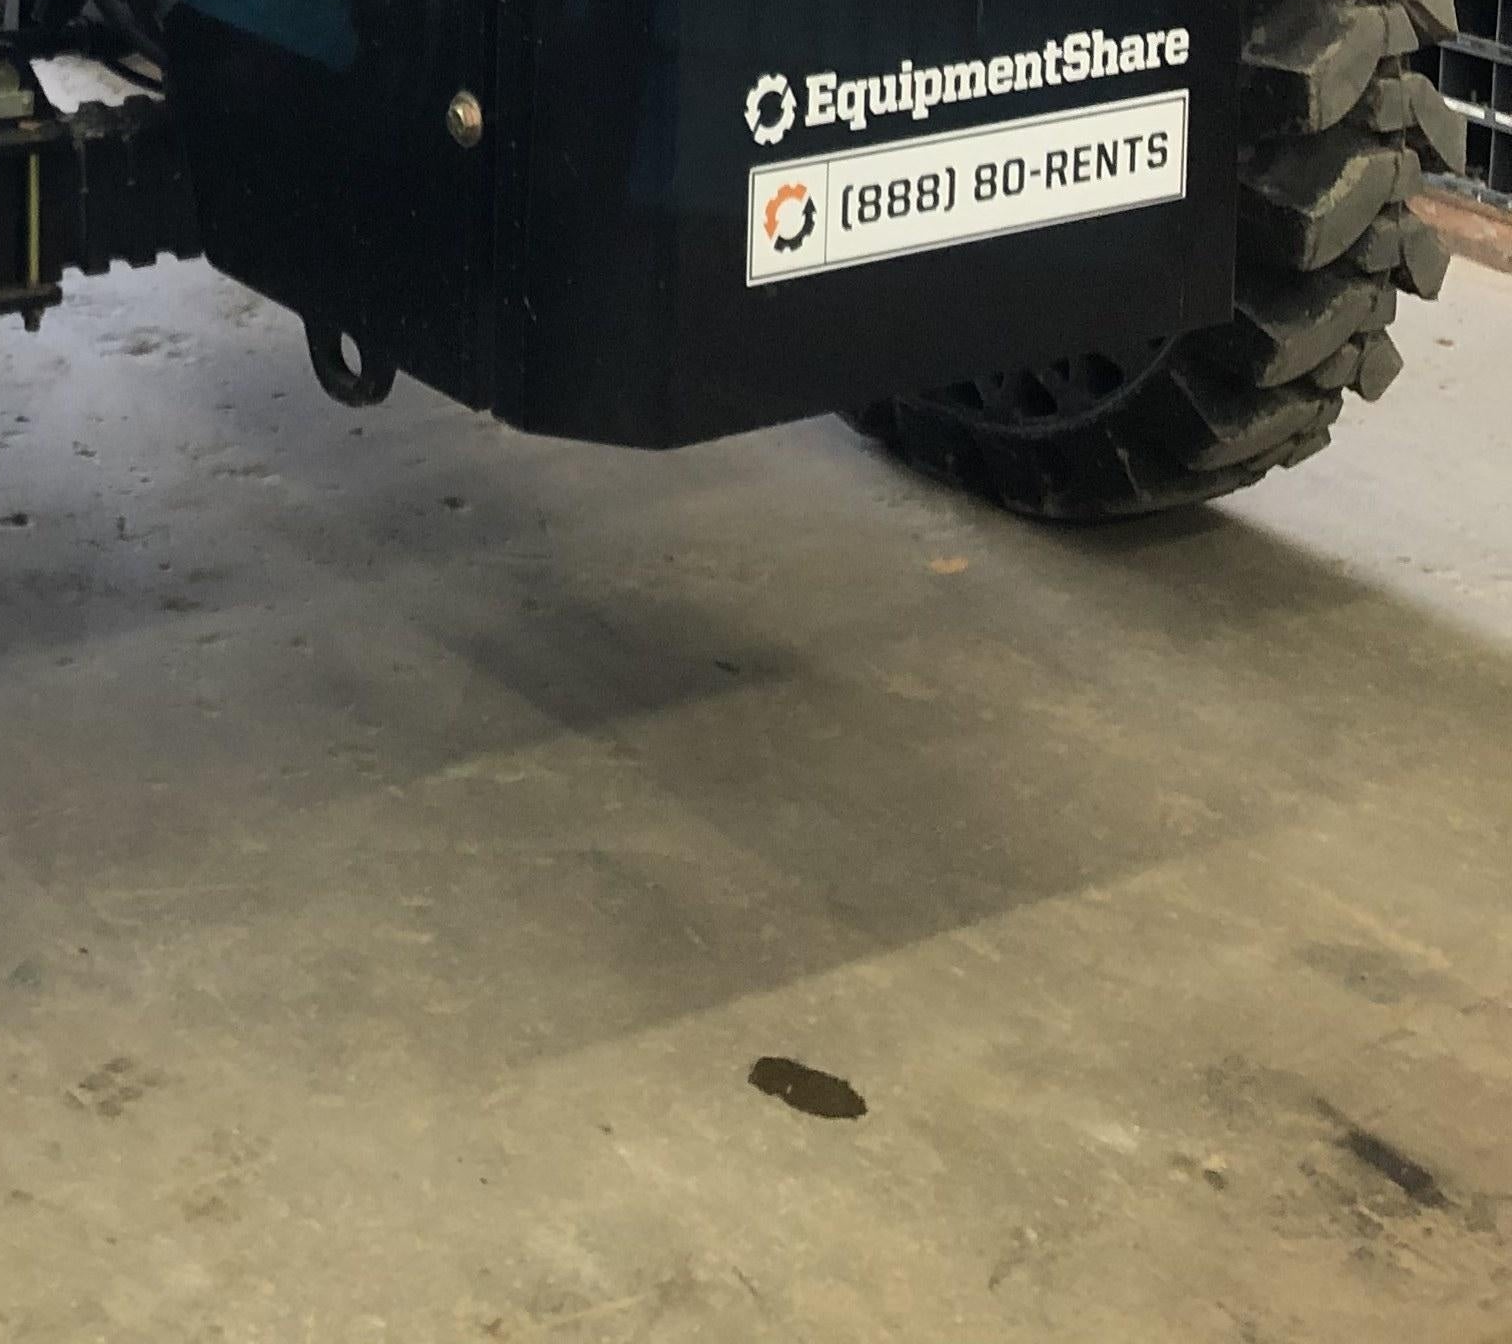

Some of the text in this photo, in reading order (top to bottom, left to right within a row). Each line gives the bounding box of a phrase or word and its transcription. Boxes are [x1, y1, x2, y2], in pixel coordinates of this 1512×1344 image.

[804, 26, 1190, 131] EquipmentShare
[841, 131, 1169, 229] (888) 80-RENTS
